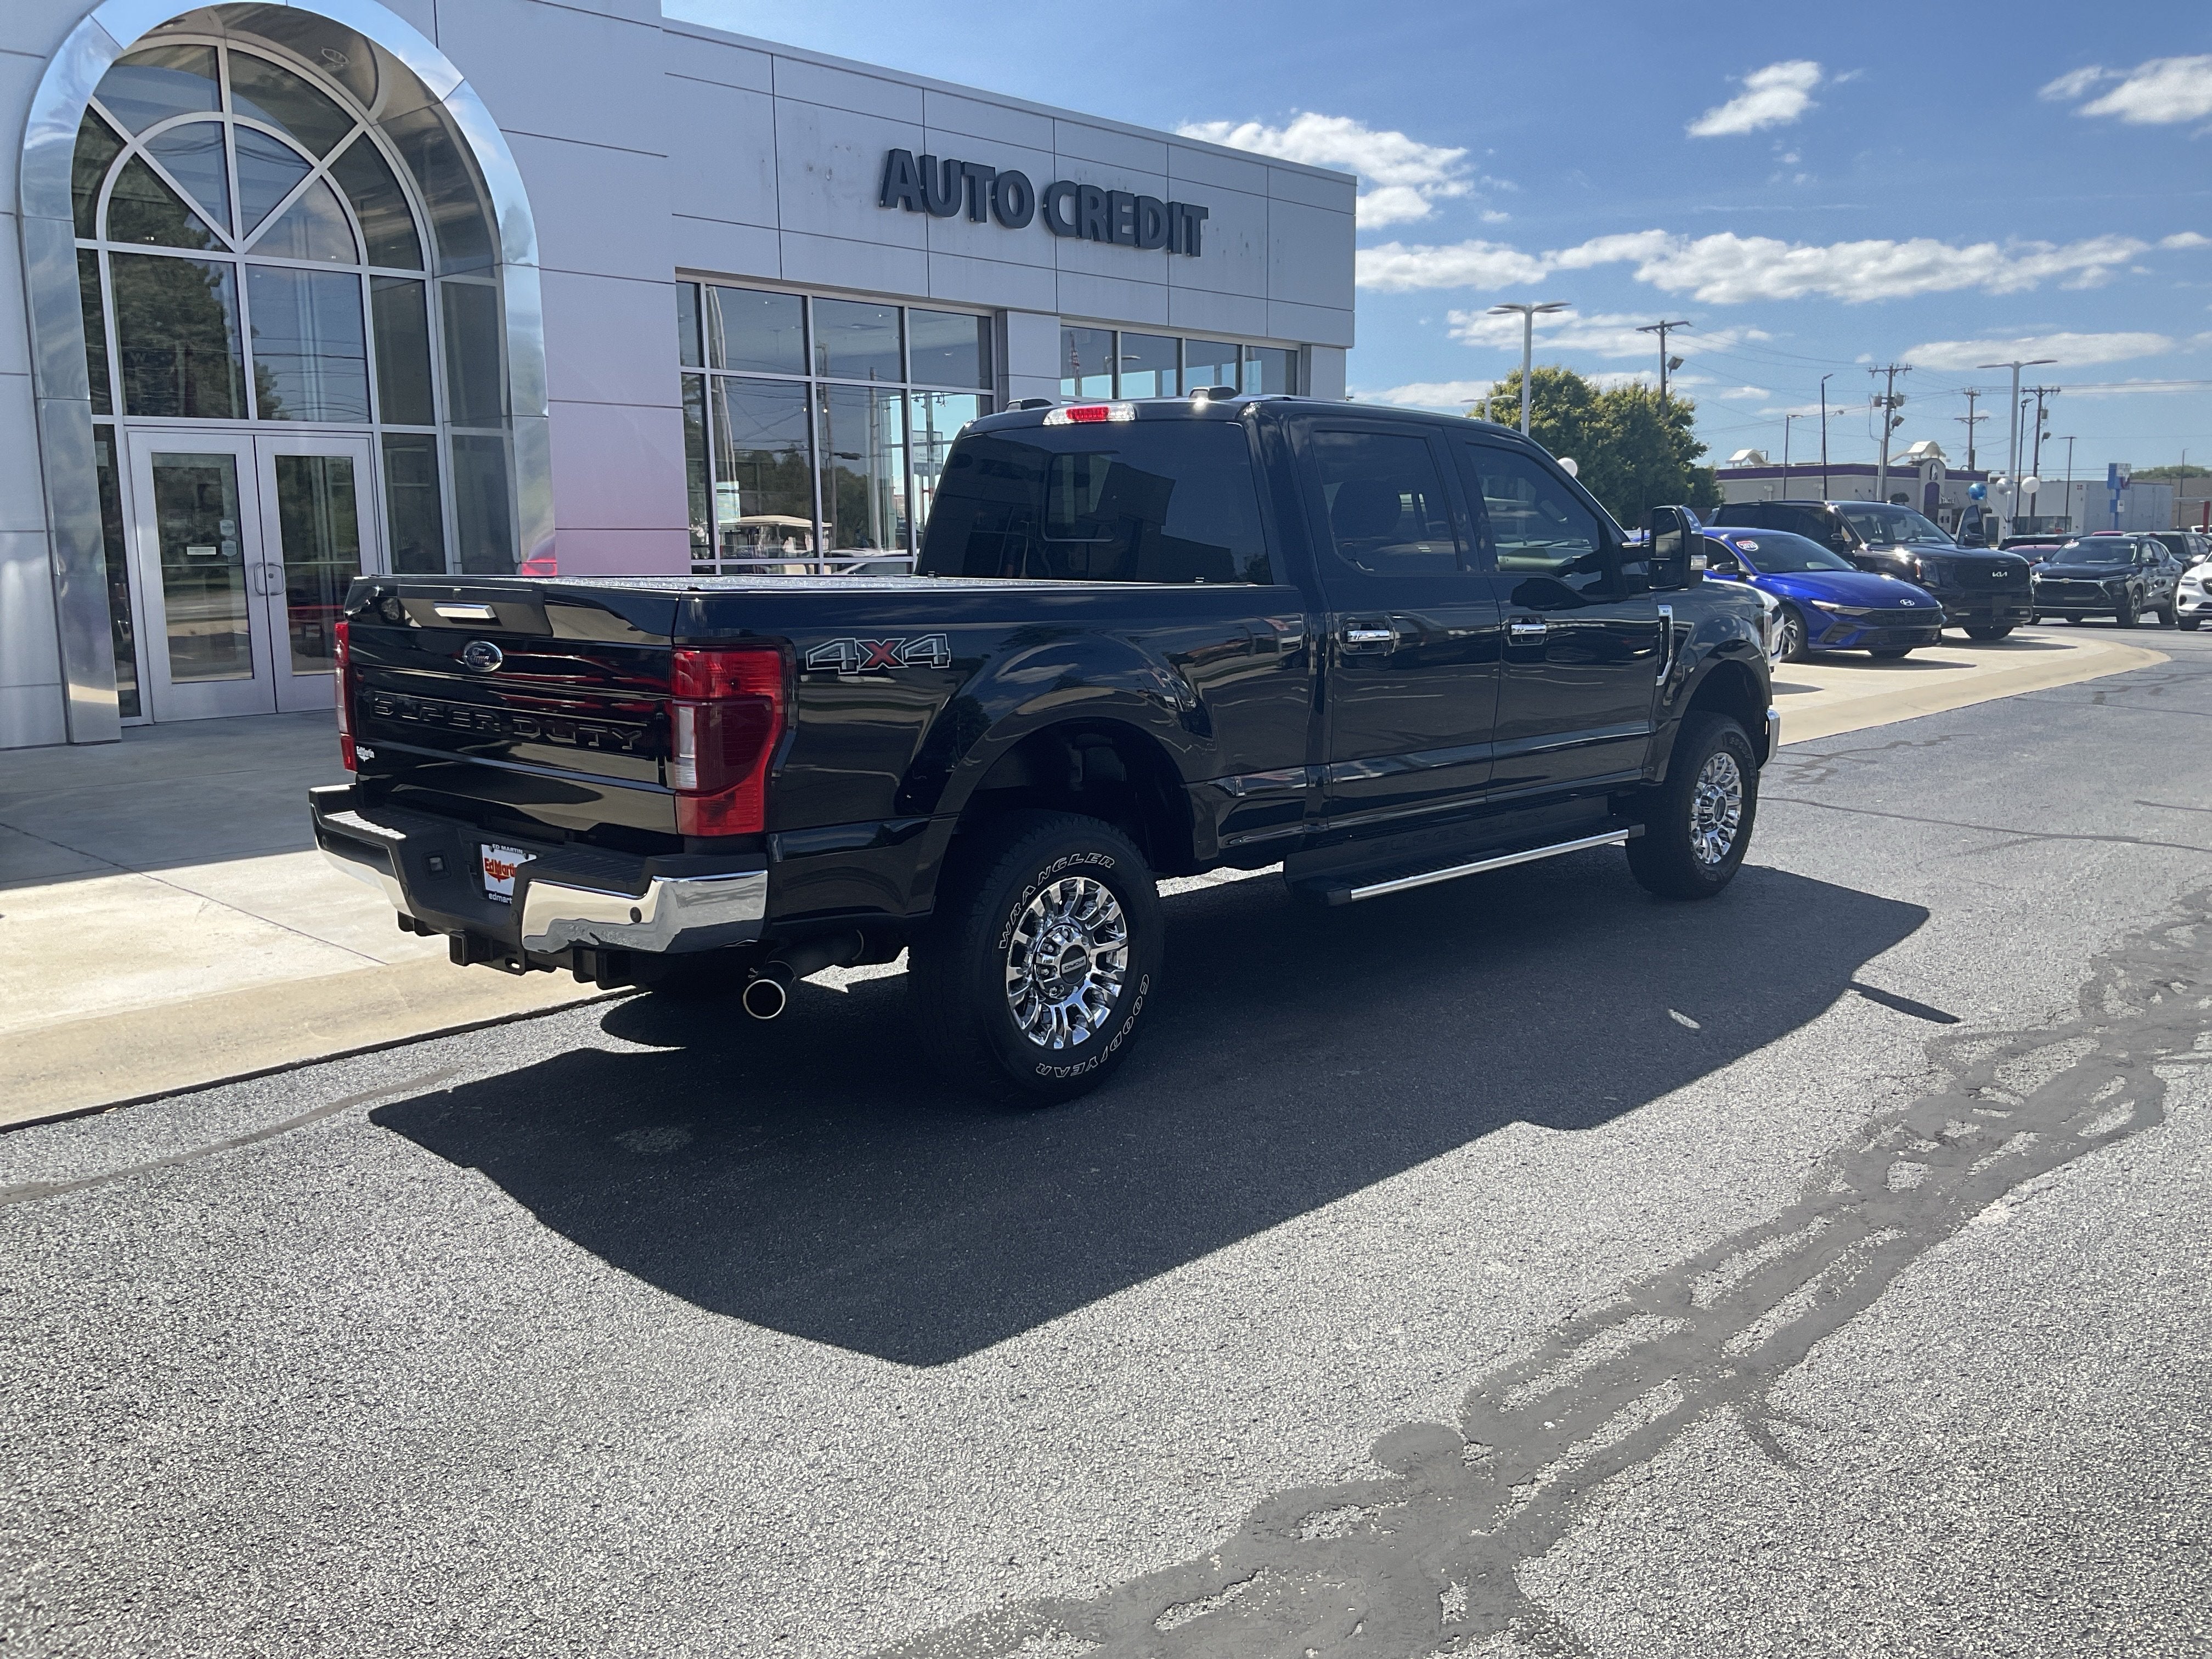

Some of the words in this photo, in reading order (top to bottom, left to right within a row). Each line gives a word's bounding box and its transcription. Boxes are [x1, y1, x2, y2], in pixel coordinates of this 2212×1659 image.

[879, 148, 1035, 229] AUTO
[1042, 180, 1209, 257] CREDIT
[512, 715, 642, 751] DUTY
[501, 845, 523, 854] MARTIN
[998, 852, 1115, 949] WRANGLER
[1036, 974, 1150, 1078] GOODYEAR
